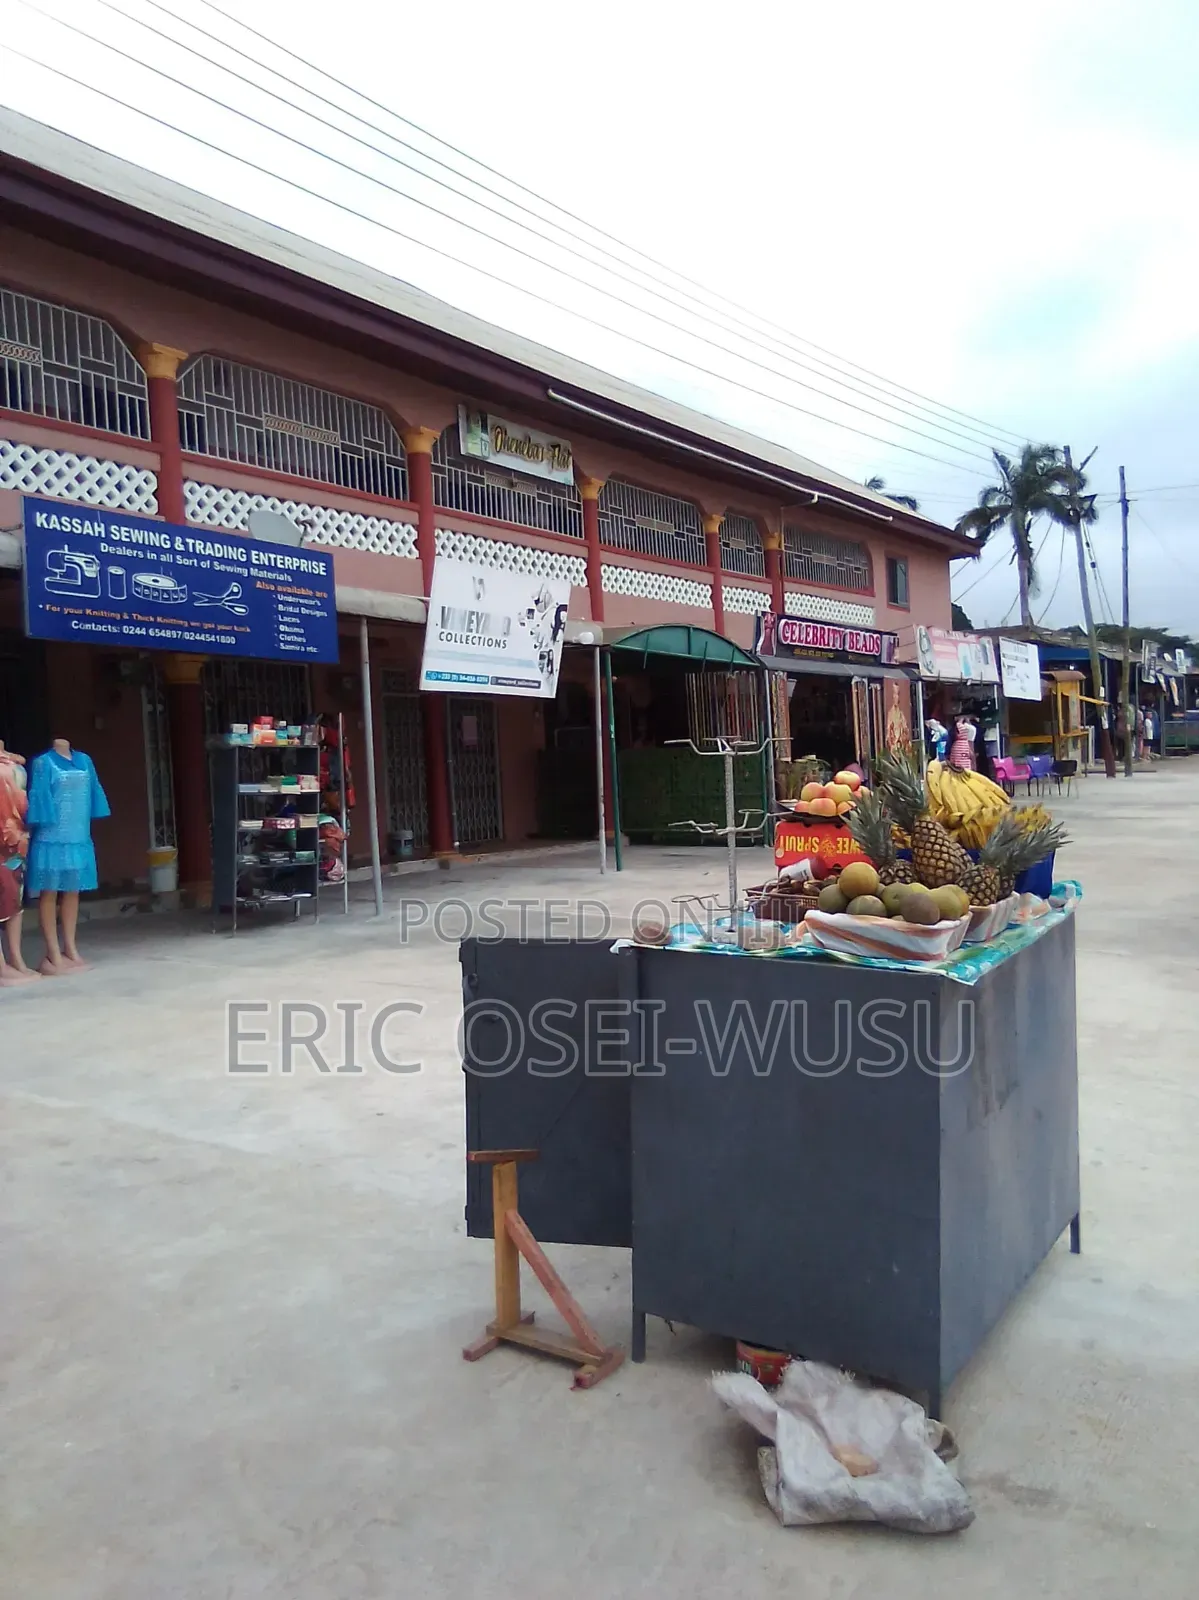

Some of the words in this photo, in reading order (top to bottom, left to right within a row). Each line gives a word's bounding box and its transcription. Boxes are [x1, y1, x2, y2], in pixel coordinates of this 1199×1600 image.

[36, 511, 106, 538] KASSAH
[110, 525, 172, 549] SEWING
[174, 536, 186, 551] &
[186, 538, 247, 562] TRADING
[251, 550, 327, 576] ENTERPRISE
[100, 542, 144, 559] Dealers
[147, 550, 157, 560] in
[160, 553, 173, 563] all
[176, 554, 198, 567] Sort
[200, 559, 210, 569] of
[213, 561, 249, 577] Sewing
[250, 567, 293, 582] Materials
[256, 581, 275, 591] Also
[46, 604, 60, 612] For
[64, 607, 83, 615] your
[85, 608, 121, 620] Knitting
[71, 620, 121, 633] Contacts:
[122, 625, 147, 635] 0244
[438, 631, 508, 650] COLLECTIONS
[780, 620, 845, 650] CELEBRITY
[848, 630, 882, 655] BEADS
